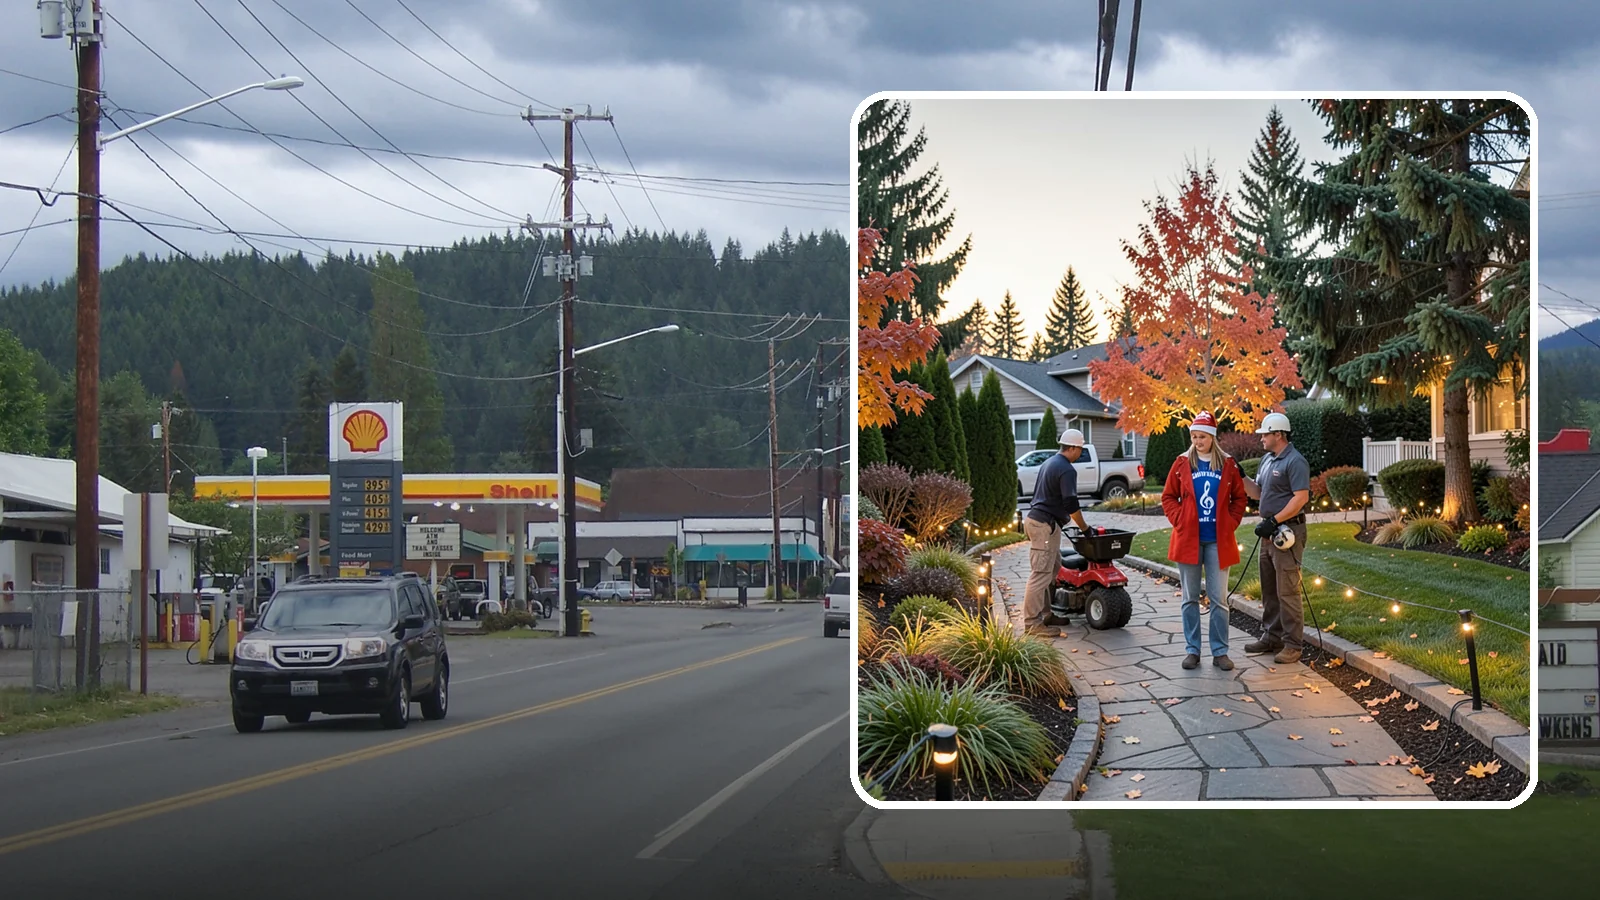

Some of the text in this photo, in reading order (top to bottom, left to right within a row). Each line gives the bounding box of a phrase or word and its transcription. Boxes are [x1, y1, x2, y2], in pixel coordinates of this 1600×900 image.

[366, 480, 383, 490] 395
[489, 484, 547, 499] Shell
[365, 494, 383, 504] 405
[365, 508, 383, 518] 415
[365, 522, 383, 532] 429
[1539, 643, 1567, 666] AID
